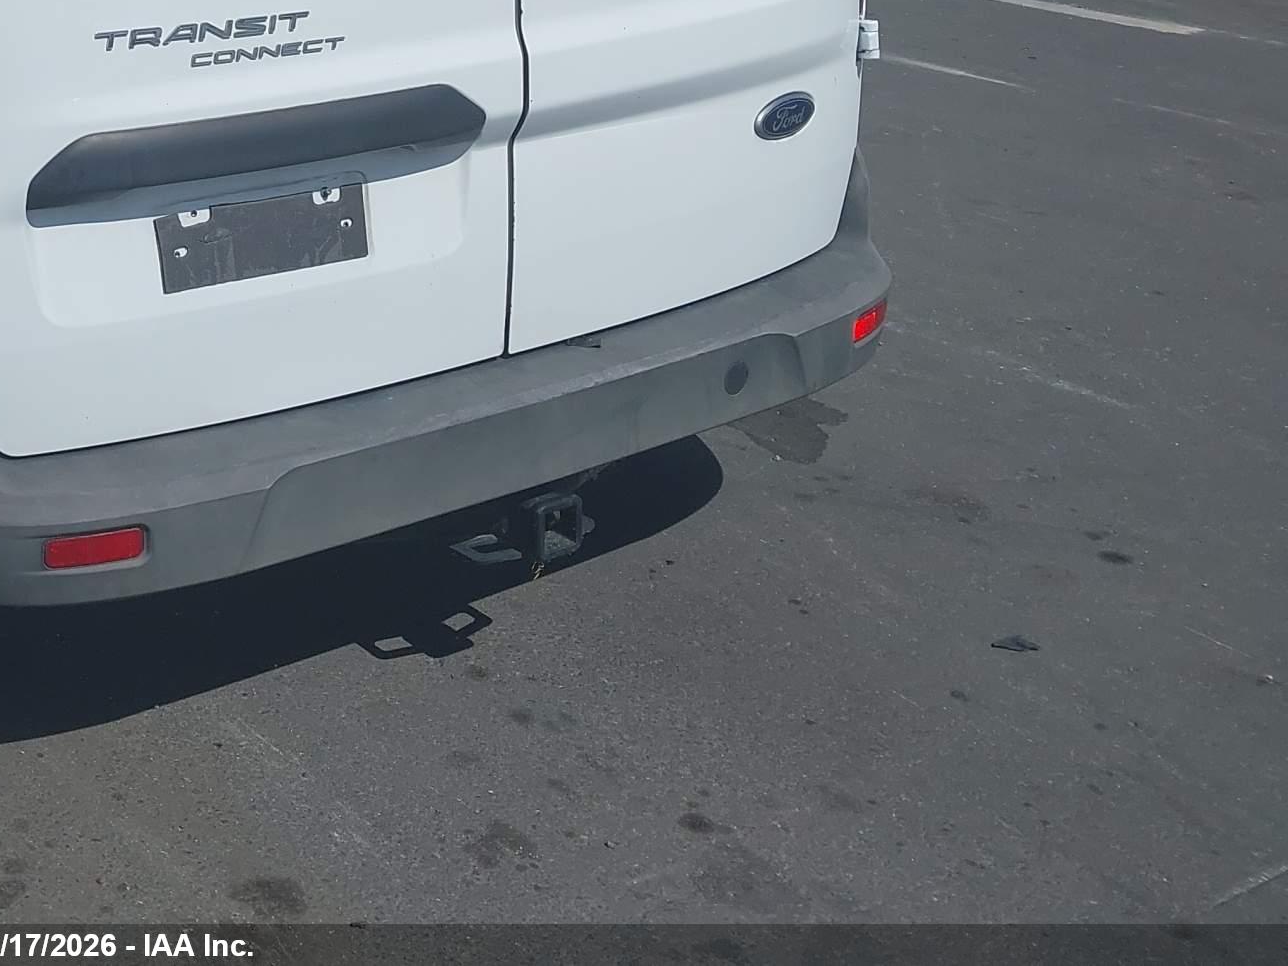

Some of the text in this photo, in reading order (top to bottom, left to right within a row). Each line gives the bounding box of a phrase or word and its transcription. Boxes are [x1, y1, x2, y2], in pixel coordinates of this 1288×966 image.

[93, 10, 310, 52] TRANSIT
[190, 36, 346, 68] CONNECT
[772, 103, 806, 132] Ford
